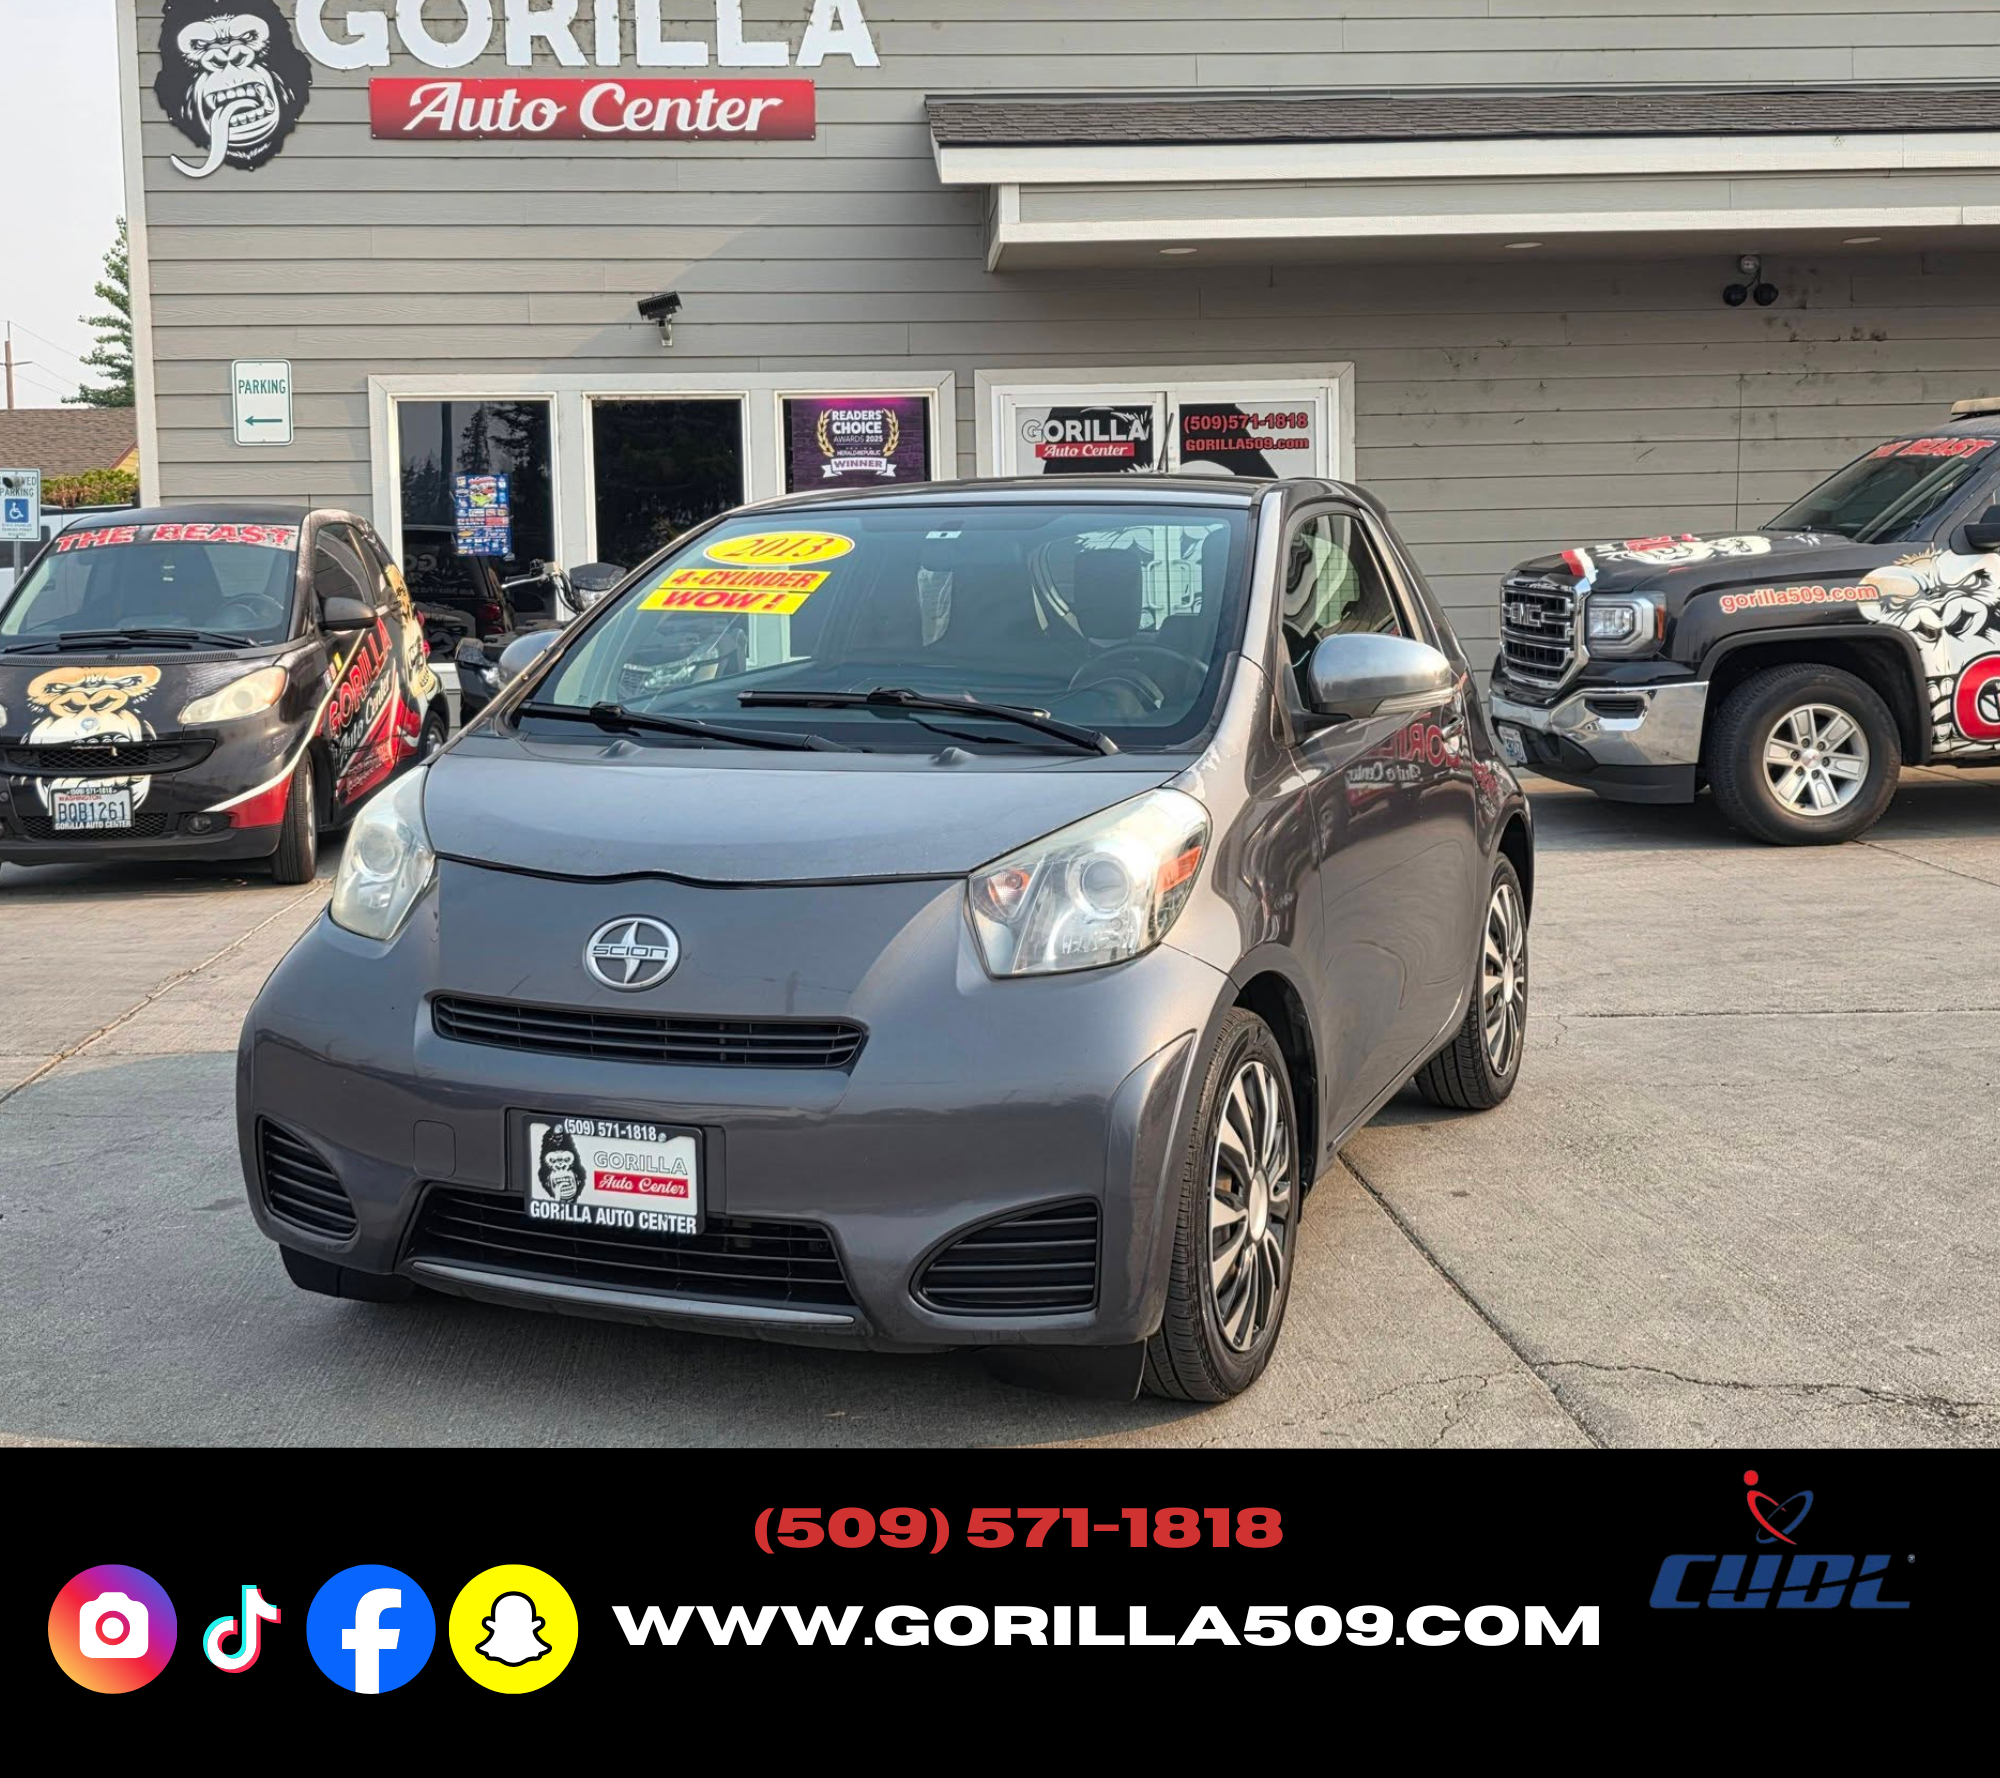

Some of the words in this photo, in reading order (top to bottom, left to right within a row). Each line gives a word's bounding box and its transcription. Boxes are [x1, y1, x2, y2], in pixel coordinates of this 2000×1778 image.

[295, 0, 881, 69] GORILLA
[403, 81, 566, 132] Auto
[579, 82, 783, 132] Center
[238, 378, 287, 395] PARKING
[832, 421, 883, 434] CHOICE
[1021, 418, 1149, 444] GORILLA
[1184, 412, 1309, 434] (509)571-1818
[833, 435, 864, 443] AWARDS
[865, 435, 883, 443] 2025
[1185, 437, 1310, 452] GORILLA509.com
[1044, 444, 1082, 458] Auto
[1082, 443, 1129, 458] Center
[834, 459, 883, 469] WINNER
[56, 525, 140, 553] THE
[151, 523, 298, 547] BEAST
[726, 537, 835, 558] 2013
[671, 571, 819, 588] 4-CYLINDER
[1719, 583, 1879, 614] gorilla509.com
[1511, 602, 1542, 628] GMC
[329, 616, 393, 739] GORILLA
[337, 719, 364, 768] Auto
[365, 671, 391, 722] Center
[58, 801, 126, 823] BQB1261
[86, 821, 103, 829] AUTO
[105, 820, 131, 828] CENTER
[592, 945, 669, 958] SCION
[564, 1118, 595, 1136] (509)
[598, 1122, 657, 1142] 571-1818
[594, 1150, 688, 1176] GORILLA
[598, 1174, 634, 1191] Auto
[637, 1177, 686, 1196] Center
[595, 1208, 635, 1228] AUTO
[638, 1214, 697, 1235] CENTER
